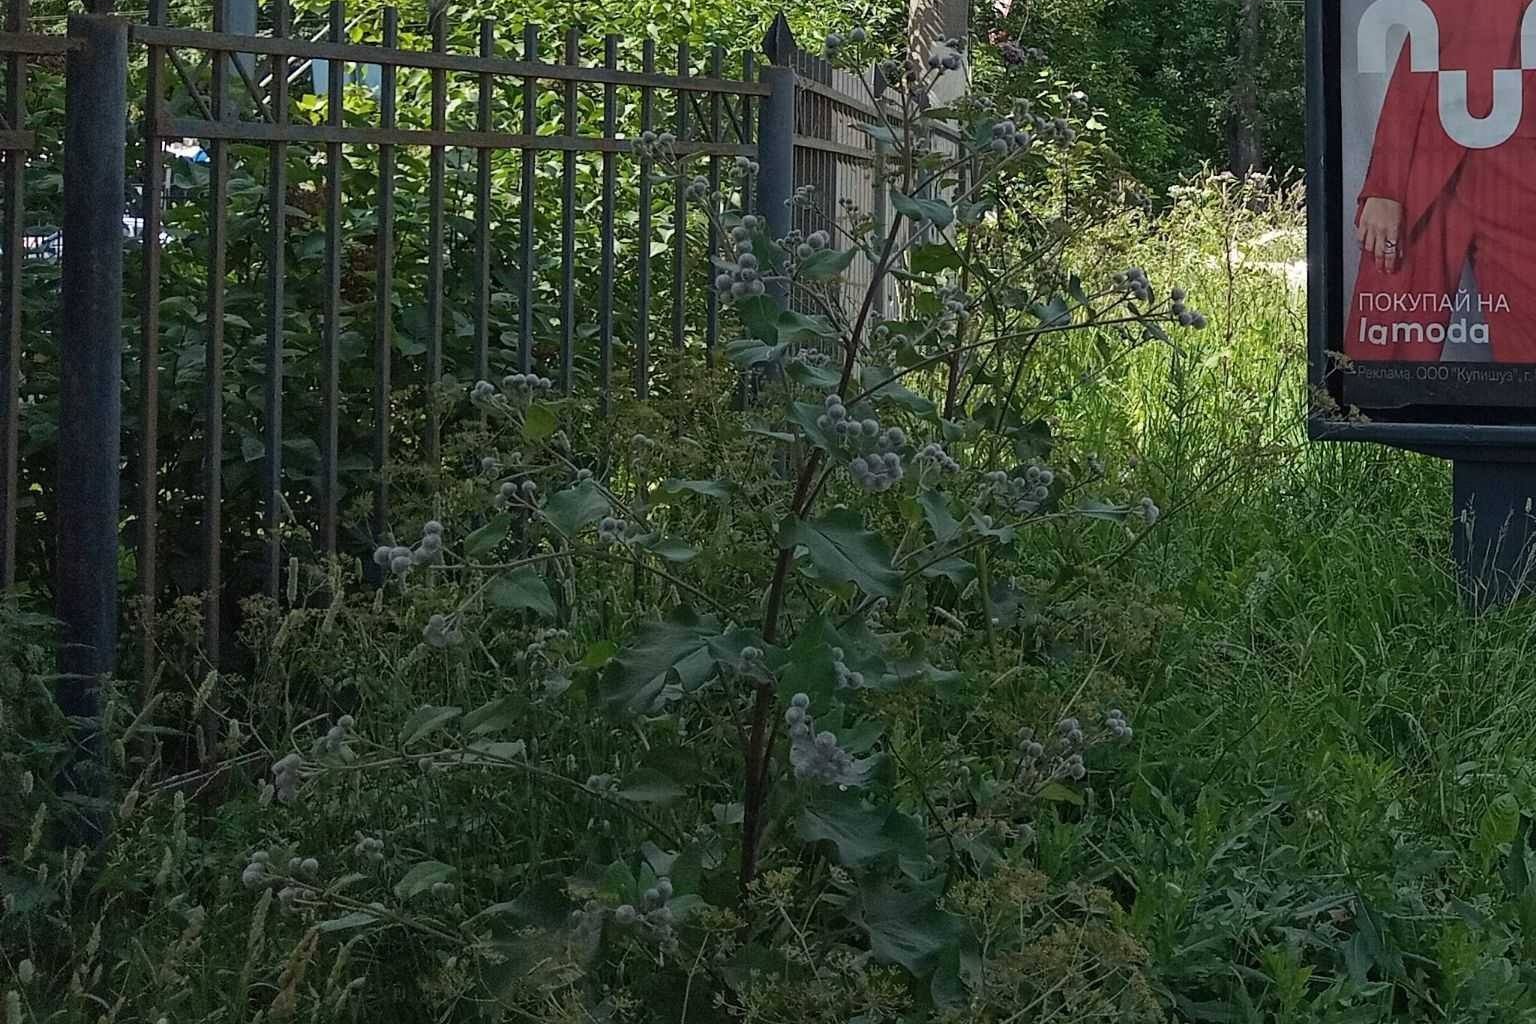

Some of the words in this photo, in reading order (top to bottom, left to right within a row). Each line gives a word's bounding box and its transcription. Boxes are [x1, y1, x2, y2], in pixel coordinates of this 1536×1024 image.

[1358, 288, 1471, 313] ПОКУПАЙ
[1477, 293, 1511, 313] НА
[1358, 316, 1490, 346] lamoda
[1415, 365, 1450, 381] ООО
